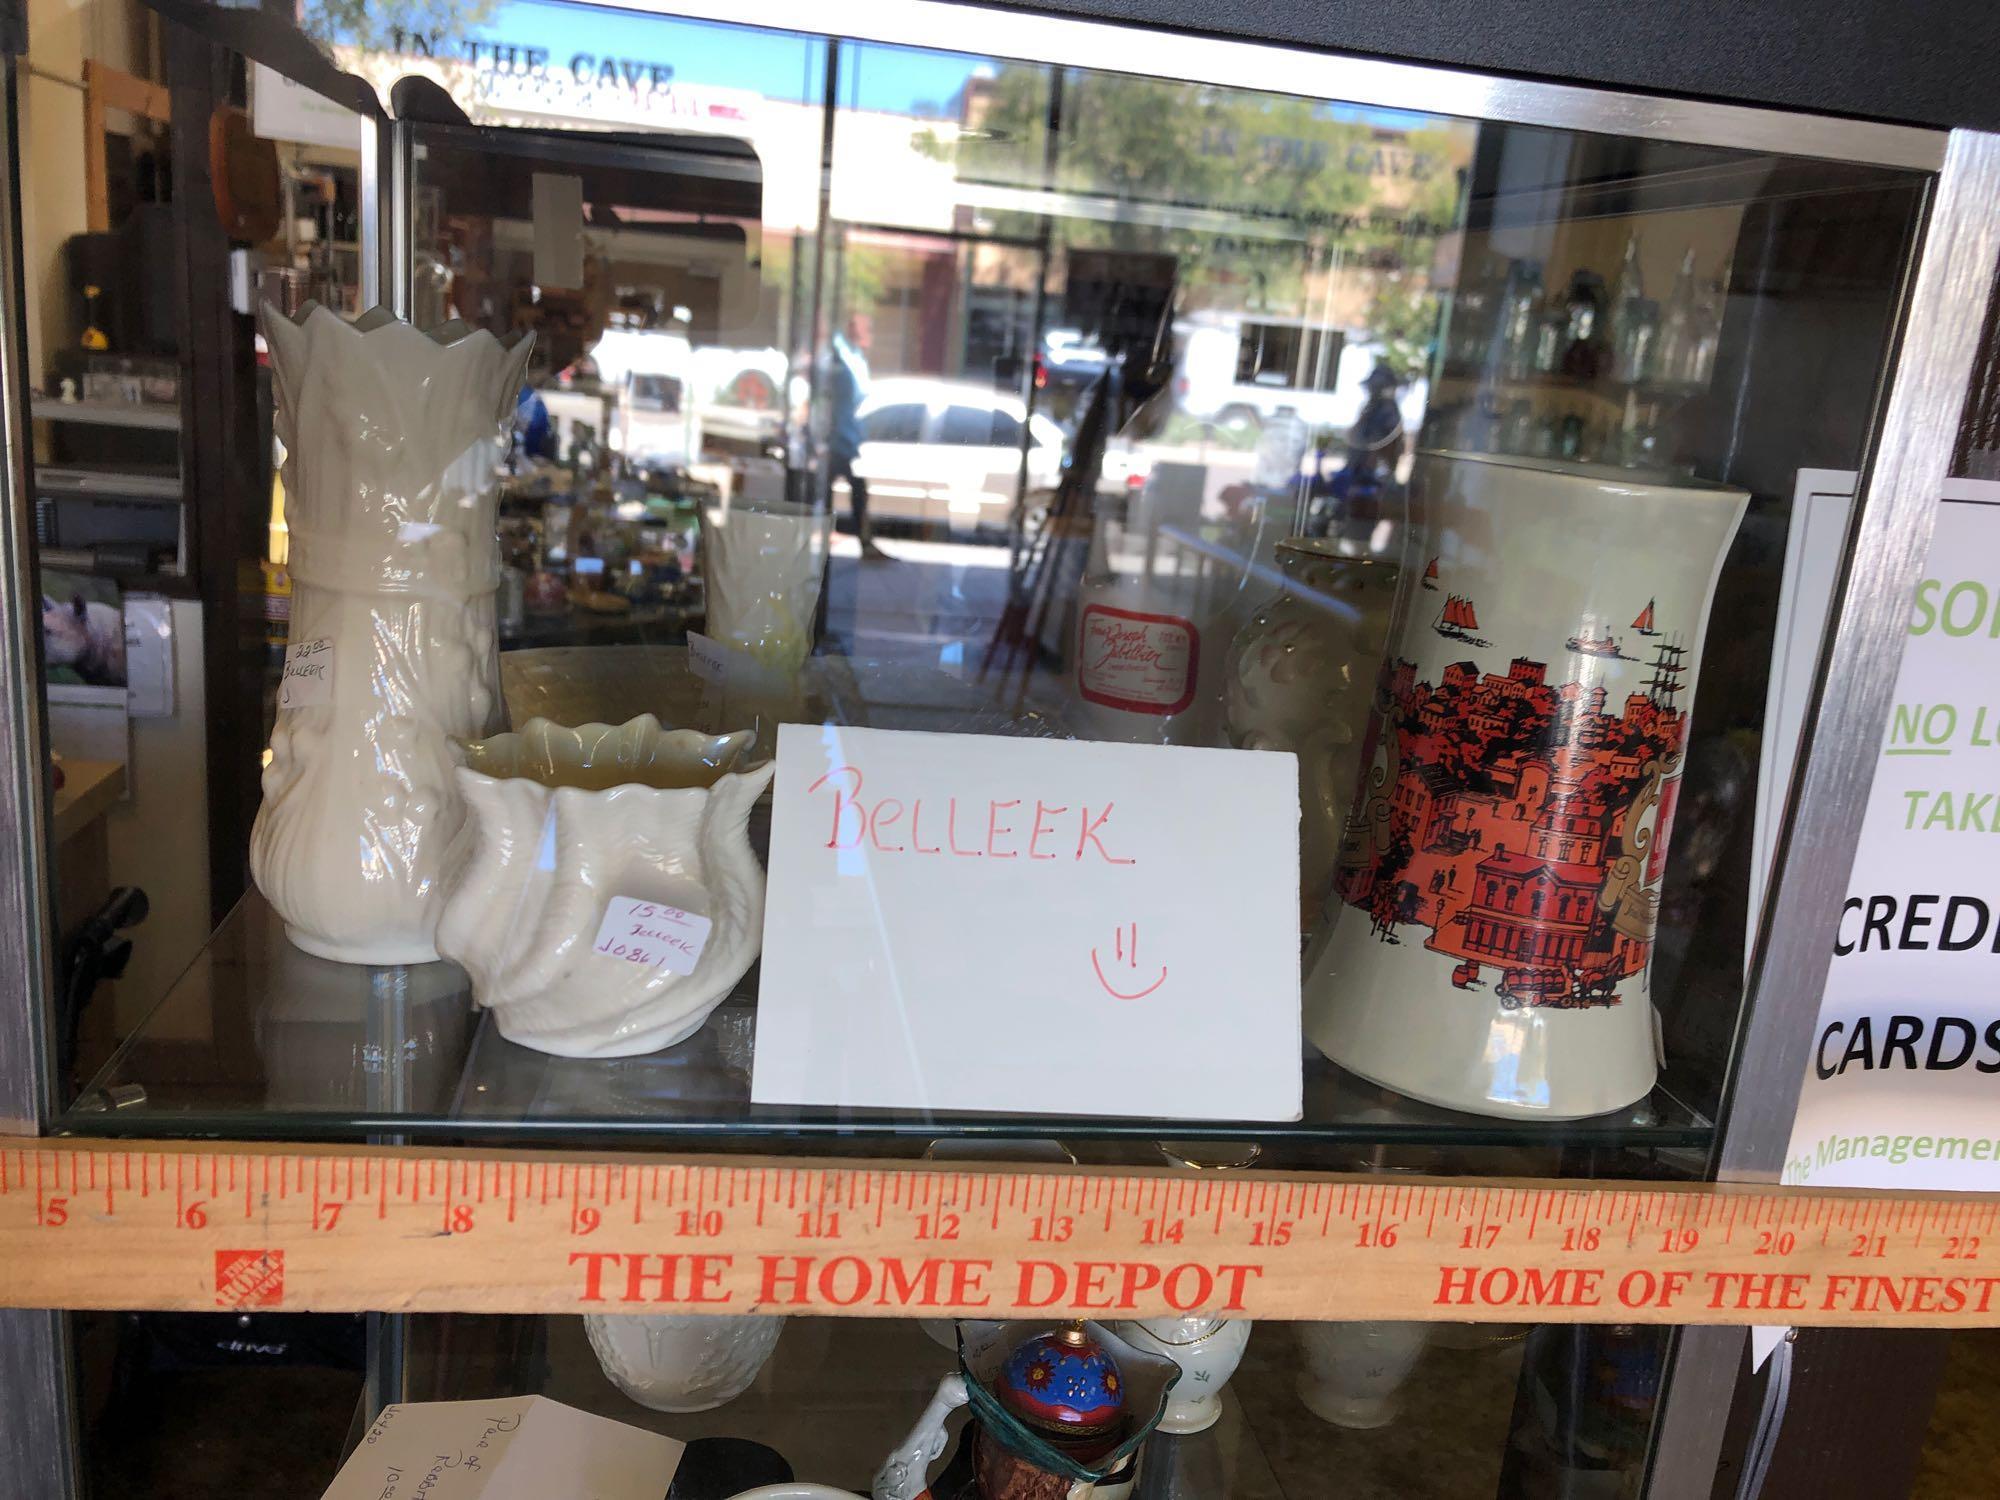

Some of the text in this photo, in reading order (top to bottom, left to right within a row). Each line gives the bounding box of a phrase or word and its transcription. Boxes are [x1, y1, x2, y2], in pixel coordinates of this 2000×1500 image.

[464, 40, 551, 79] THE
[569, 53, 674, 95] CAVE
[1908, 578, 2000, 639] SO
[1889, 703, 2000, 748] NO L
[1816, 1014, 2000, 1081] CARDS
[1786, 1153, 1811, 1185] The
[45, 1198, 1980, 1260] 5 6 7 8 9 10 11 12 13 14 15 16 17 18 19 20 21 22
[216, 1252, 281, 1306] HOME
[568, 1252, 1263, 1311] THE HOME DEPOT
[1433, 1265, 2000, 1313] HOME OF THE FINEST
